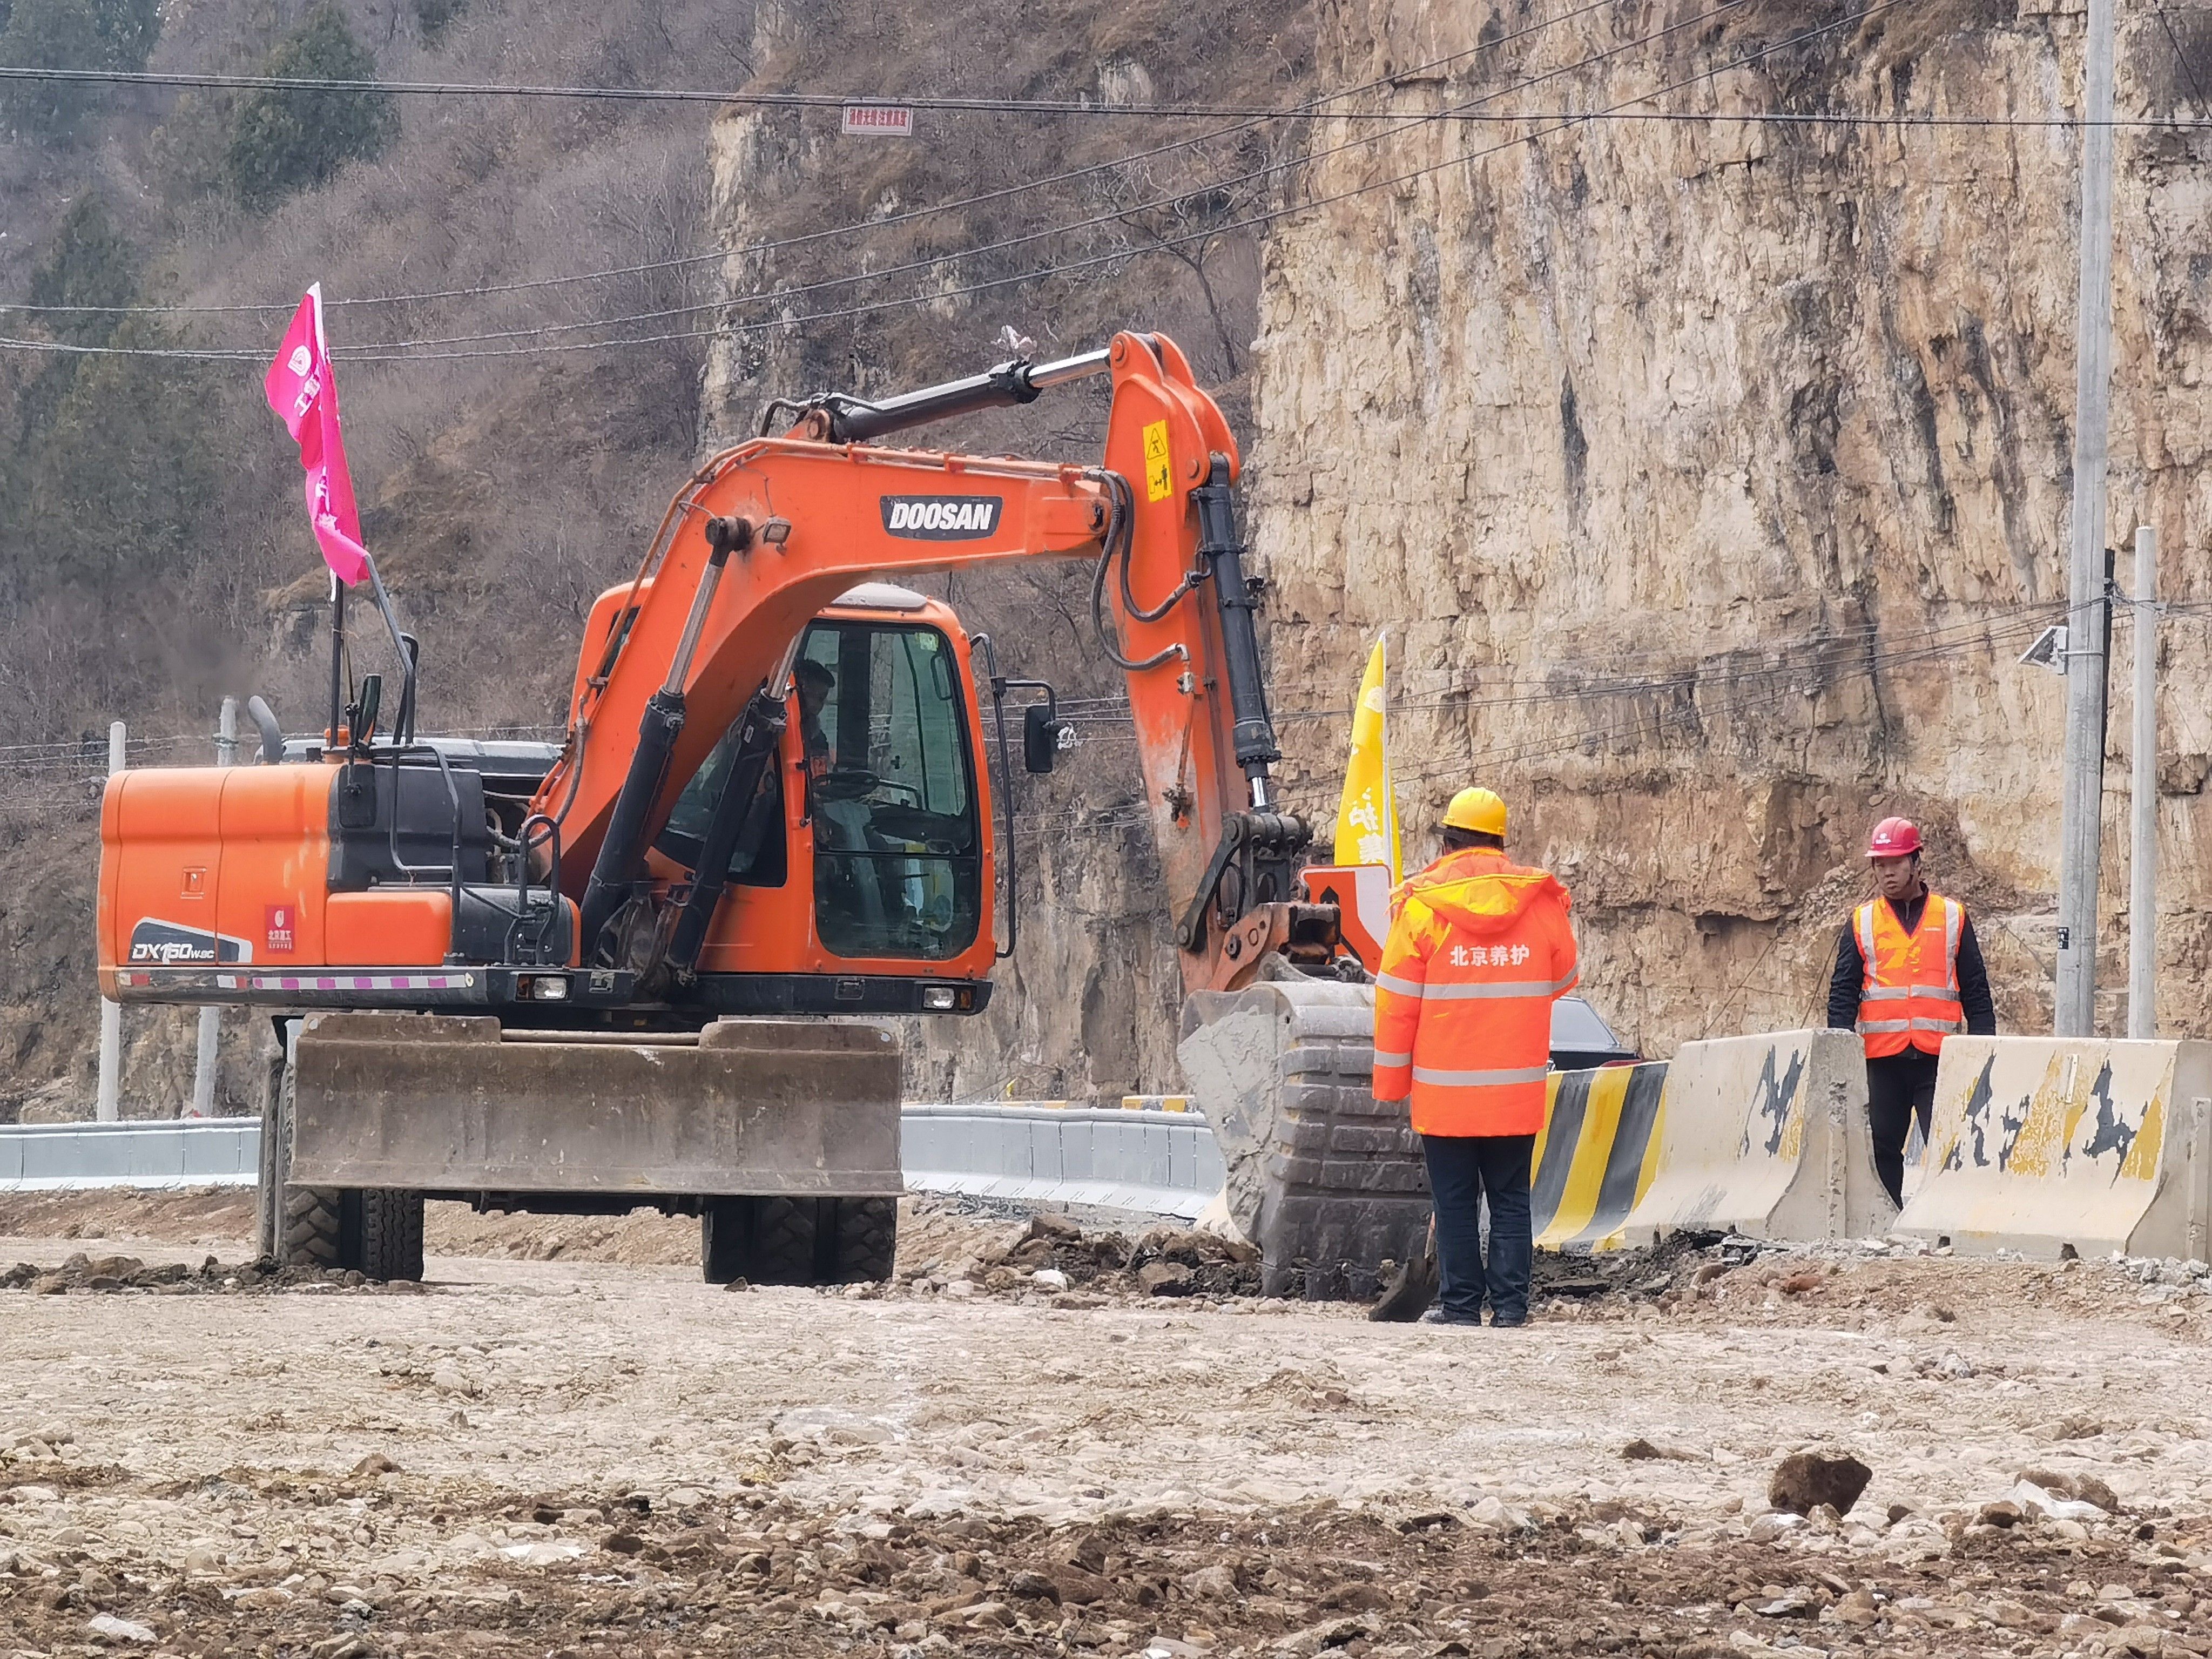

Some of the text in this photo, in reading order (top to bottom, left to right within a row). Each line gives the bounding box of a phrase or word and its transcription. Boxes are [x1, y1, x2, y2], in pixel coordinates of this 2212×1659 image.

[889, 503, 993, 530] DOOSAN
[1450, 944, 1530, 967] 北京养护
